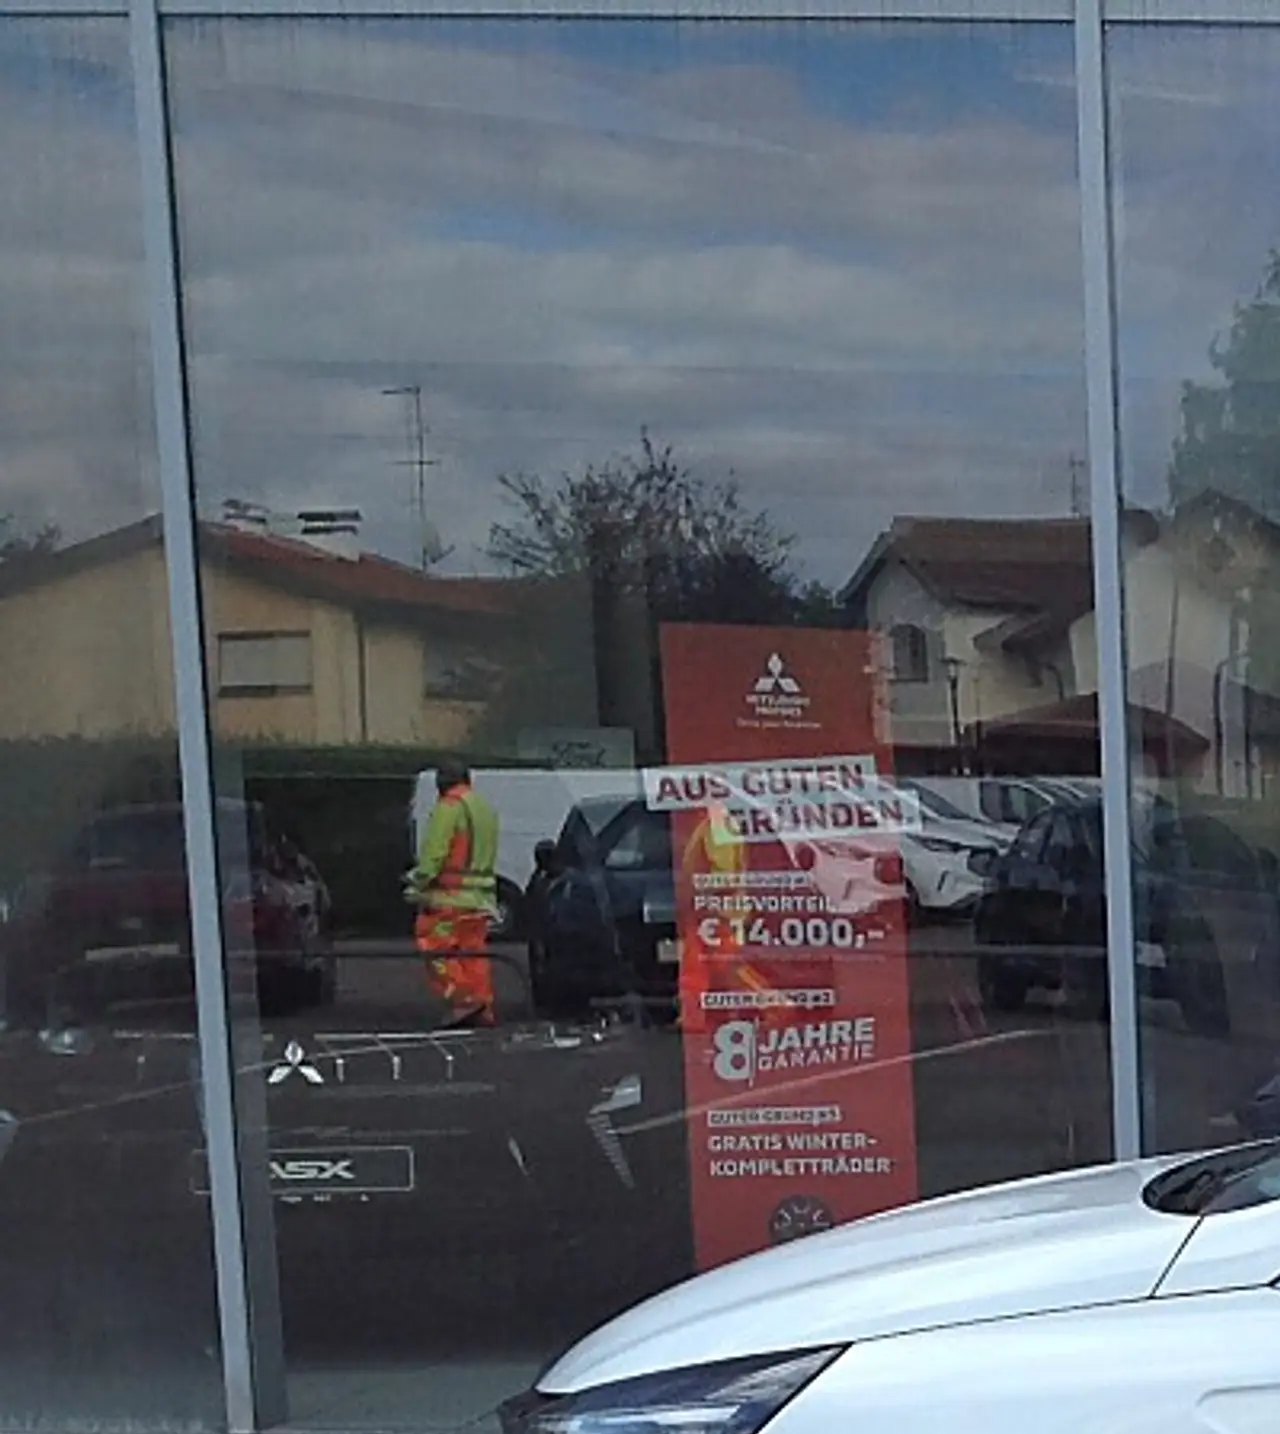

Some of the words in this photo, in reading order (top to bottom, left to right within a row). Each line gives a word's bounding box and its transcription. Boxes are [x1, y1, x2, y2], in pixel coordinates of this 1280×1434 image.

[656, 772, 731, 803] AUS
[742, 763, 866, 797] GUTEN
[698, 918, 721, 946] €
[713, 1020, 756, 1082] 8
[759, 1018, 876, 1052] JAHRE
[758, 1042, 875, 1071] GARANTIE
[708, 1136, 783, 1151] GRATIS
[787, 1133, 878, 1150] WINTER-
[710, 1154, 892, 1176] KOMPLETTRÄDER
